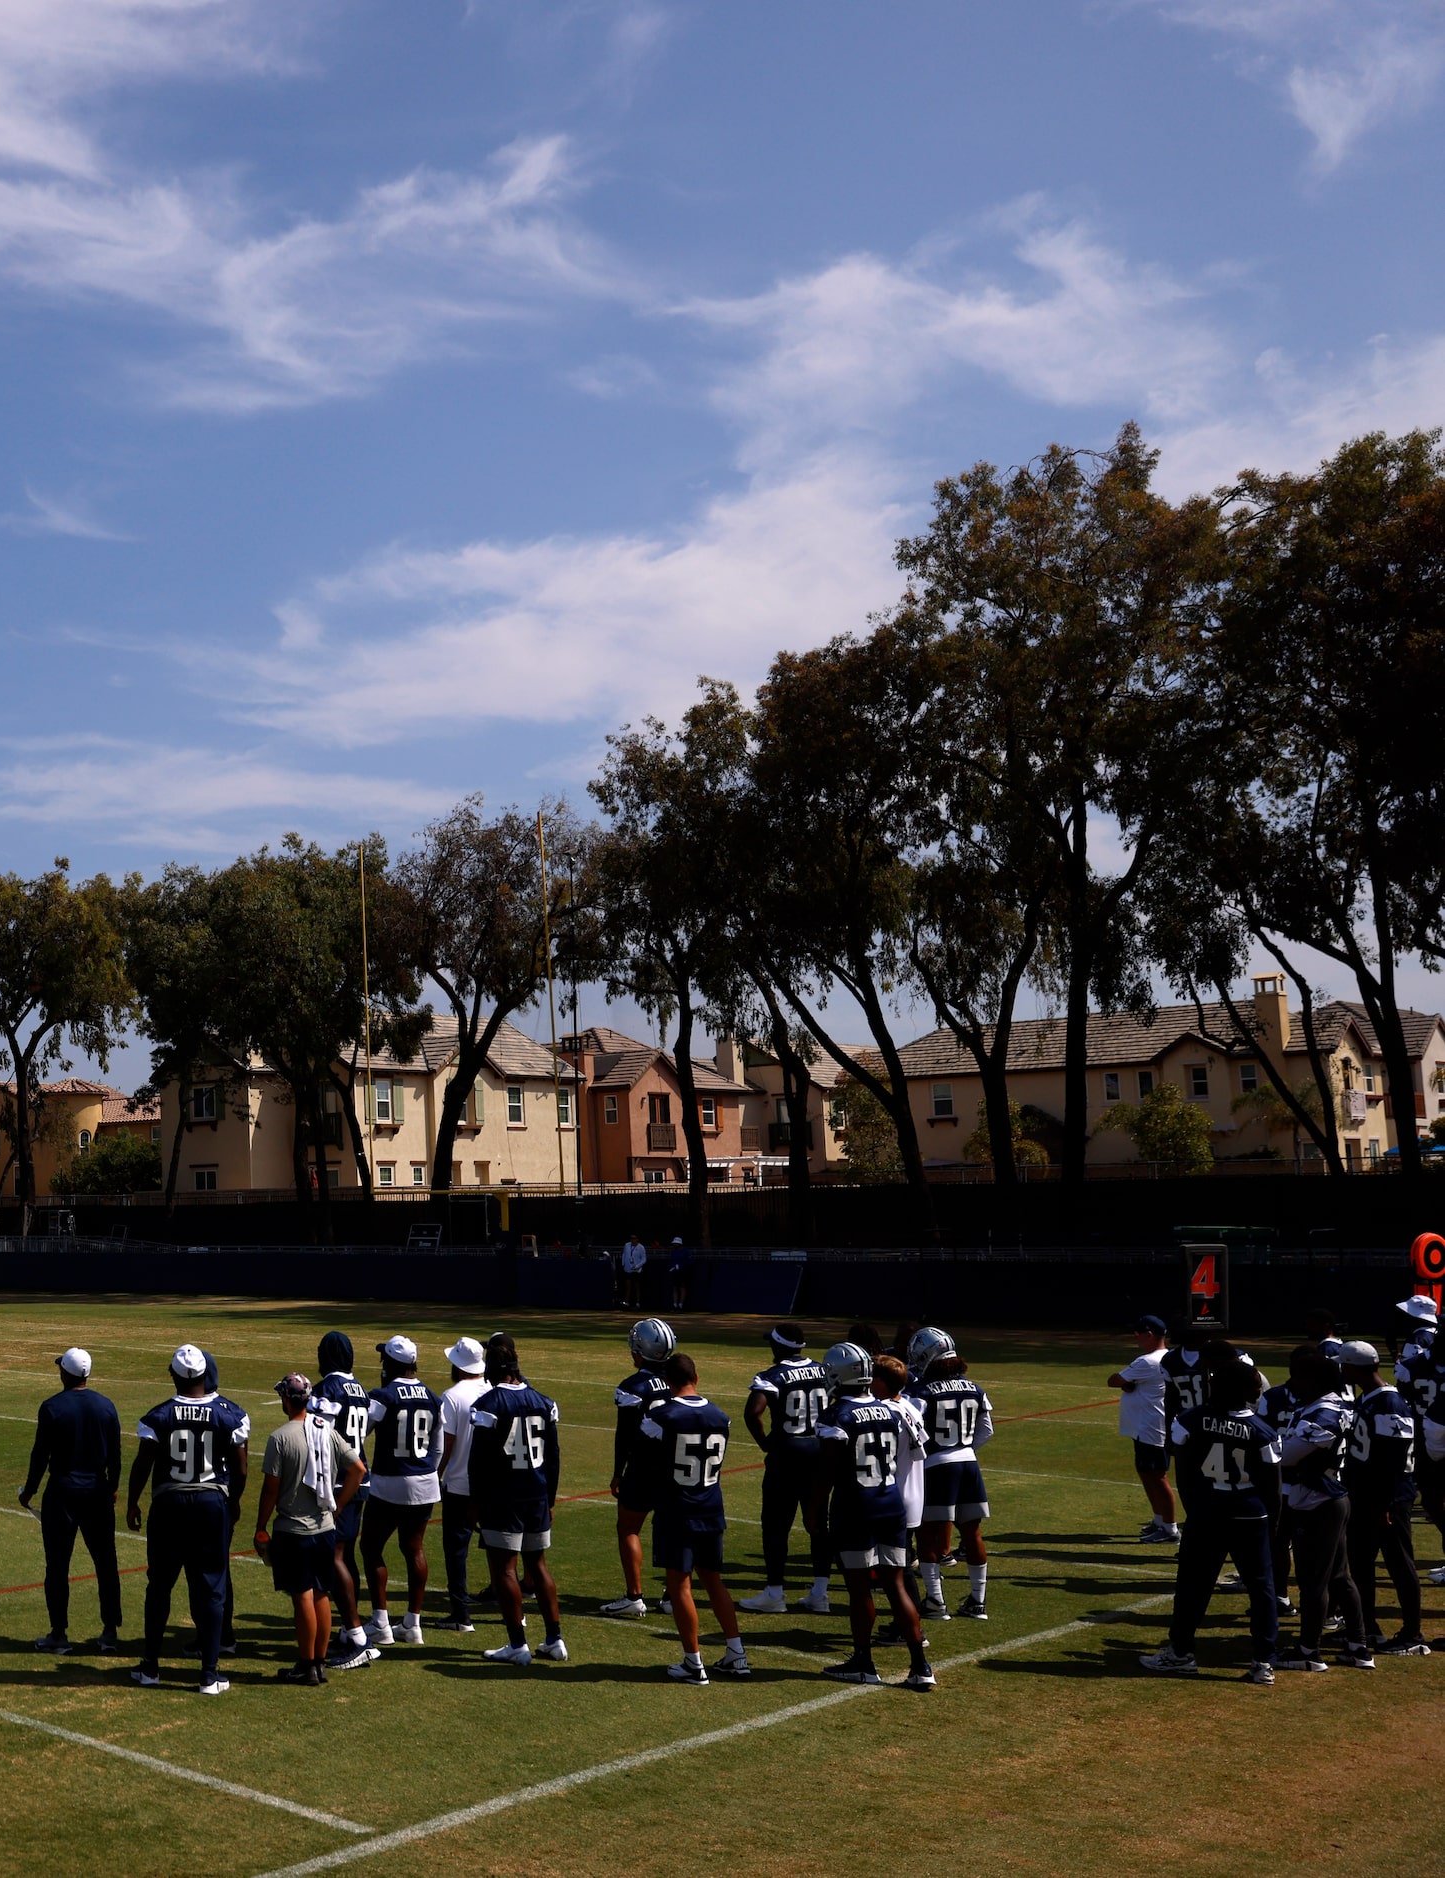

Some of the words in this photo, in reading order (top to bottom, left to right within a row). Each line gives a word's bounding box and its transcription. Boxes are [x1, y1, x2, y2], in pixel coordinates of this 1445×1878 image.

[1190, 1254, 1221, 1299] 4
[174, 1405, 213, 1422] WHEAT
[396, 1385, 430, 1400] CLARK
[782, 1387, 829, 1434] 90
[851, 1406, 893, 1424] JOHNSON
[393, 1408, 434, 1459] 18
[502, 1415, 546, 1470] 46
[934, 1398, 980, 1448] 50
[1202, 1416, 1253, 1441] CARSON
[169, 1428, 216, 1483] 91
[672, 1432, 727, 1488] 52
[855, 1431, 898, 1488] 53
[1200, 1442, 1255, 1491] 41
